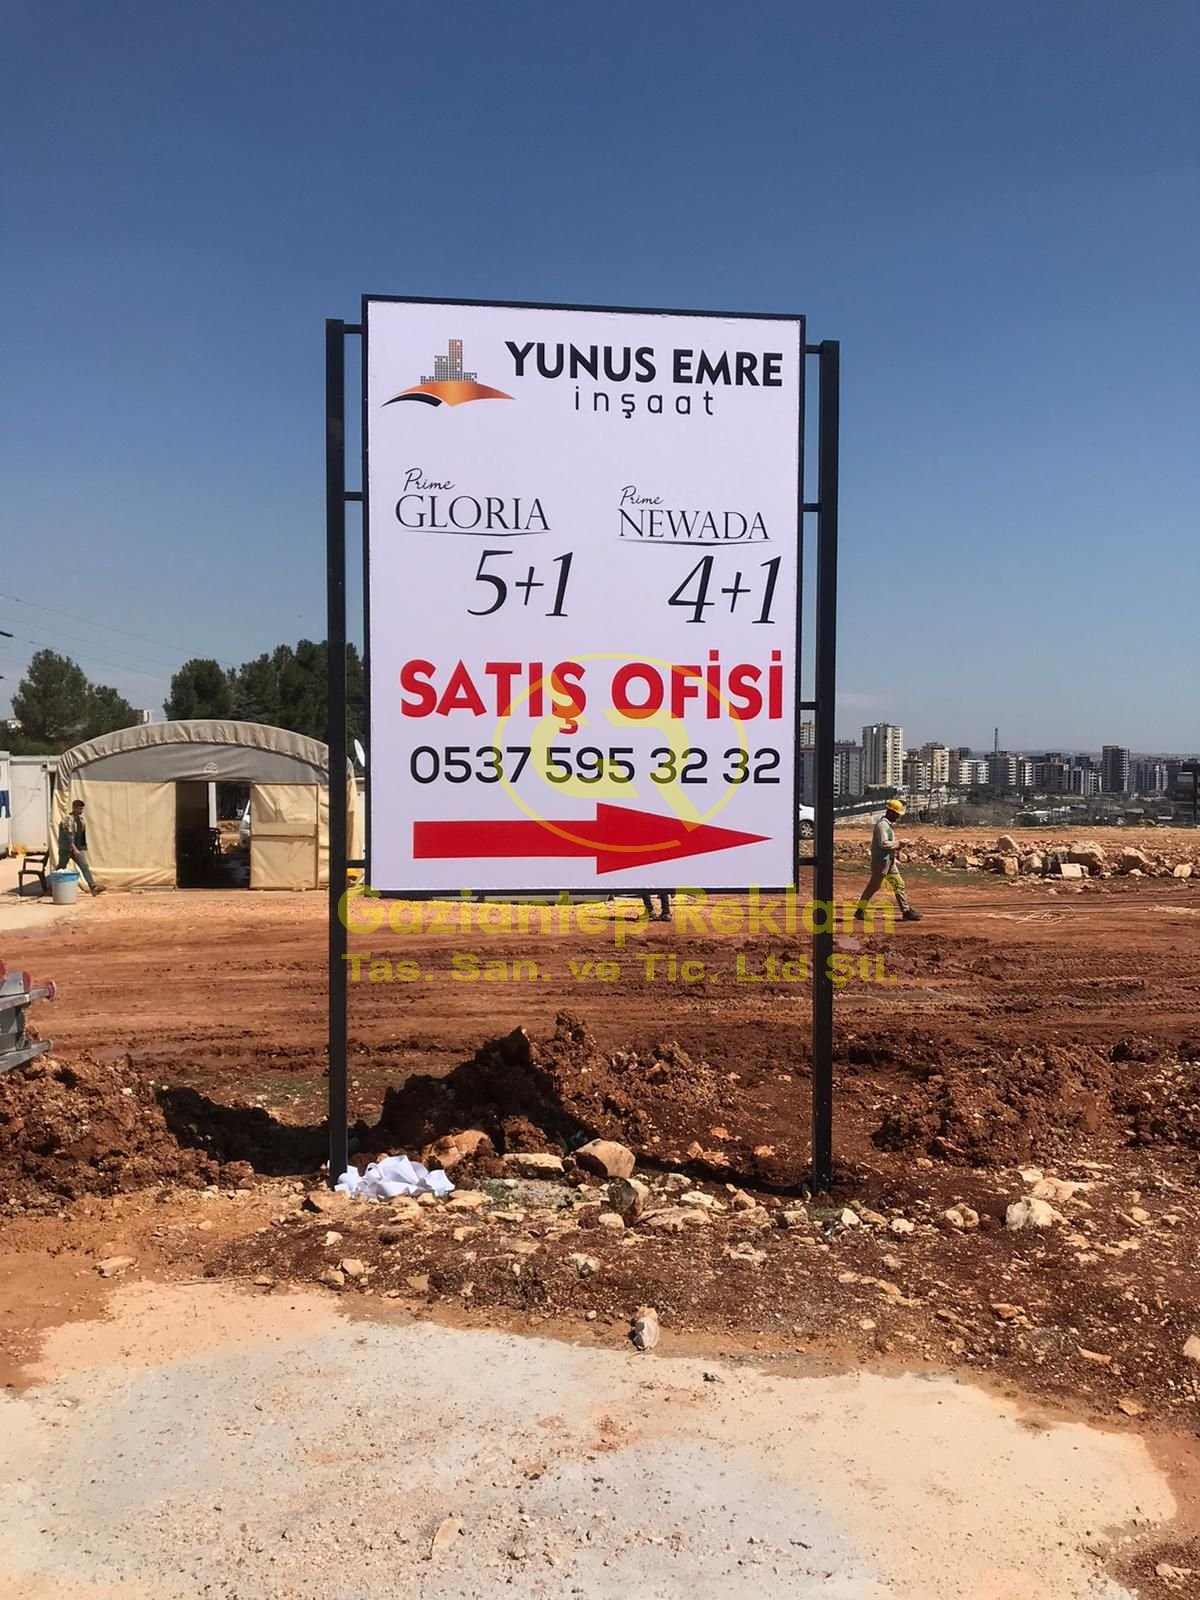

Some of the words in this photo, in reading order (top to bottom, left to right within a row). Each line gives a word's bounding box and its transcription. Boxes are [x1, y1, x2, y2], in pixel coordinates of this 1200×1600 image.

[504, 340, 657, 384] YUNUS
[672, 348, 783, 387] EMRE
[574, 386, 714, 419] inşaat
[403, 467, 456, 492] Prime
[619, 485, 664, 507] Prime
[395, 494, 551, 531] GLORIA
[617, 508, 771, 540] NEWADA
[467, 549, 574, 617] 5+1
[667, 555, 782, 625] 4+1
[400, 659, 587, 735] SATIŞ
[611, 649, 783, 721] OFİSİ
[410, 745, 531, 785] 0537
[545, 746, 636, 784] 595
[649, 747, 708, 784] 32
[722, 747, 781, 785] 32
